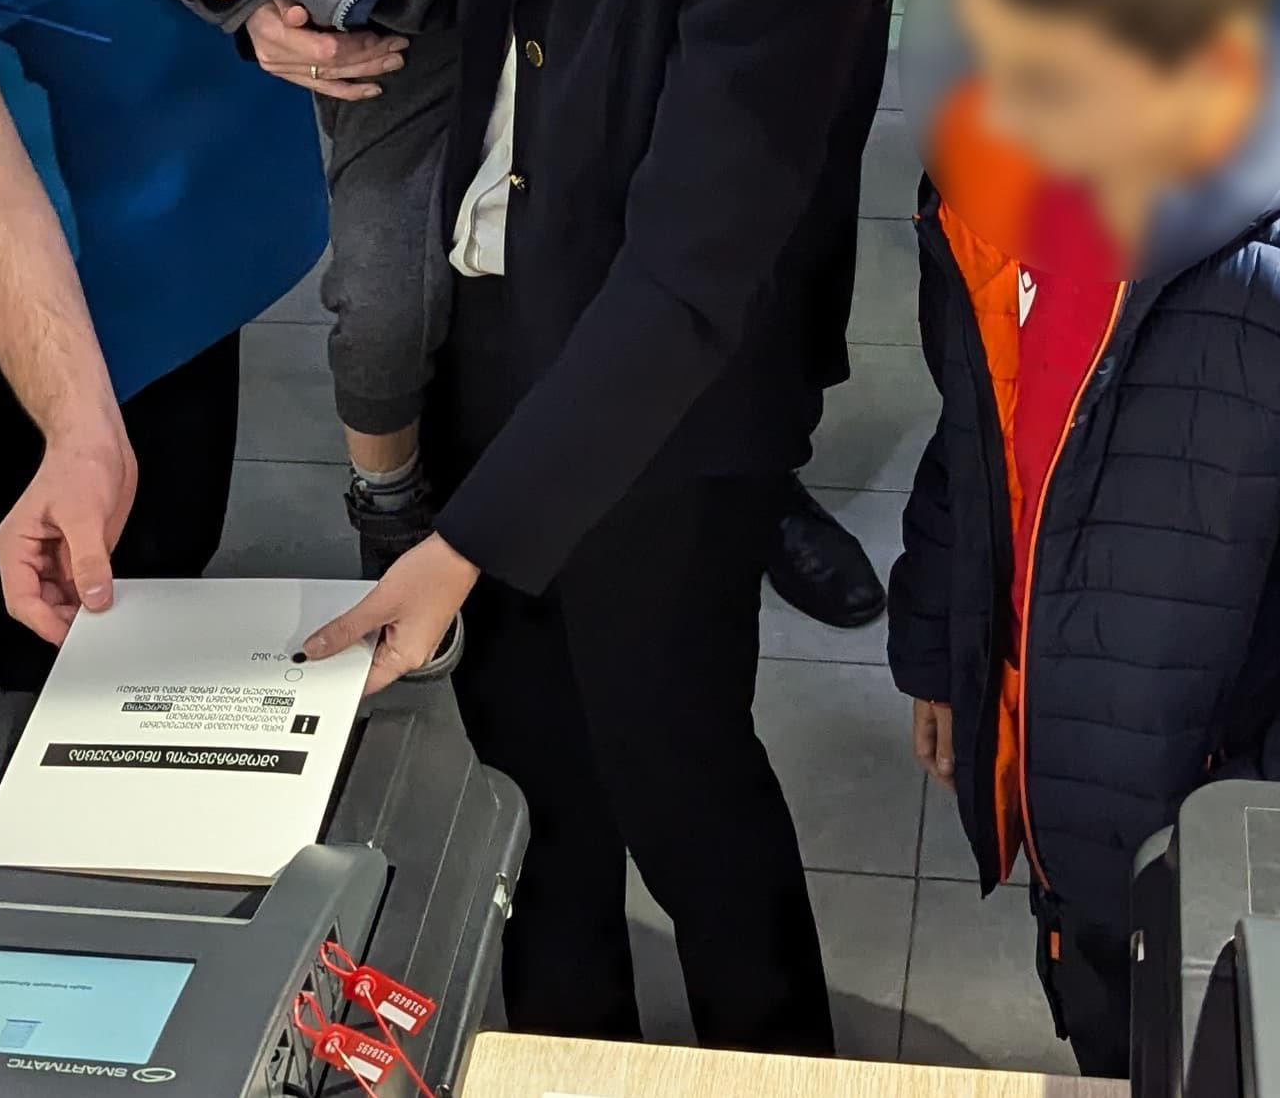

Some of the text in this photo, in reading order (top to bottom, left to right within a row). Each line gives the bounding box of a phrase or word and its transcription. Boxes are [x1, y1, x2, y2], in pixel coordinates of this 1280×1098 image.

[68, 748, 279, 767] ამომრჩევლის ინსტრუქცია
[388, 990, 428, 1017] 4318494
[356, 1042, 394, 1065] 4318495
[7, 1058, 128, 1078] SMARTMATIC
